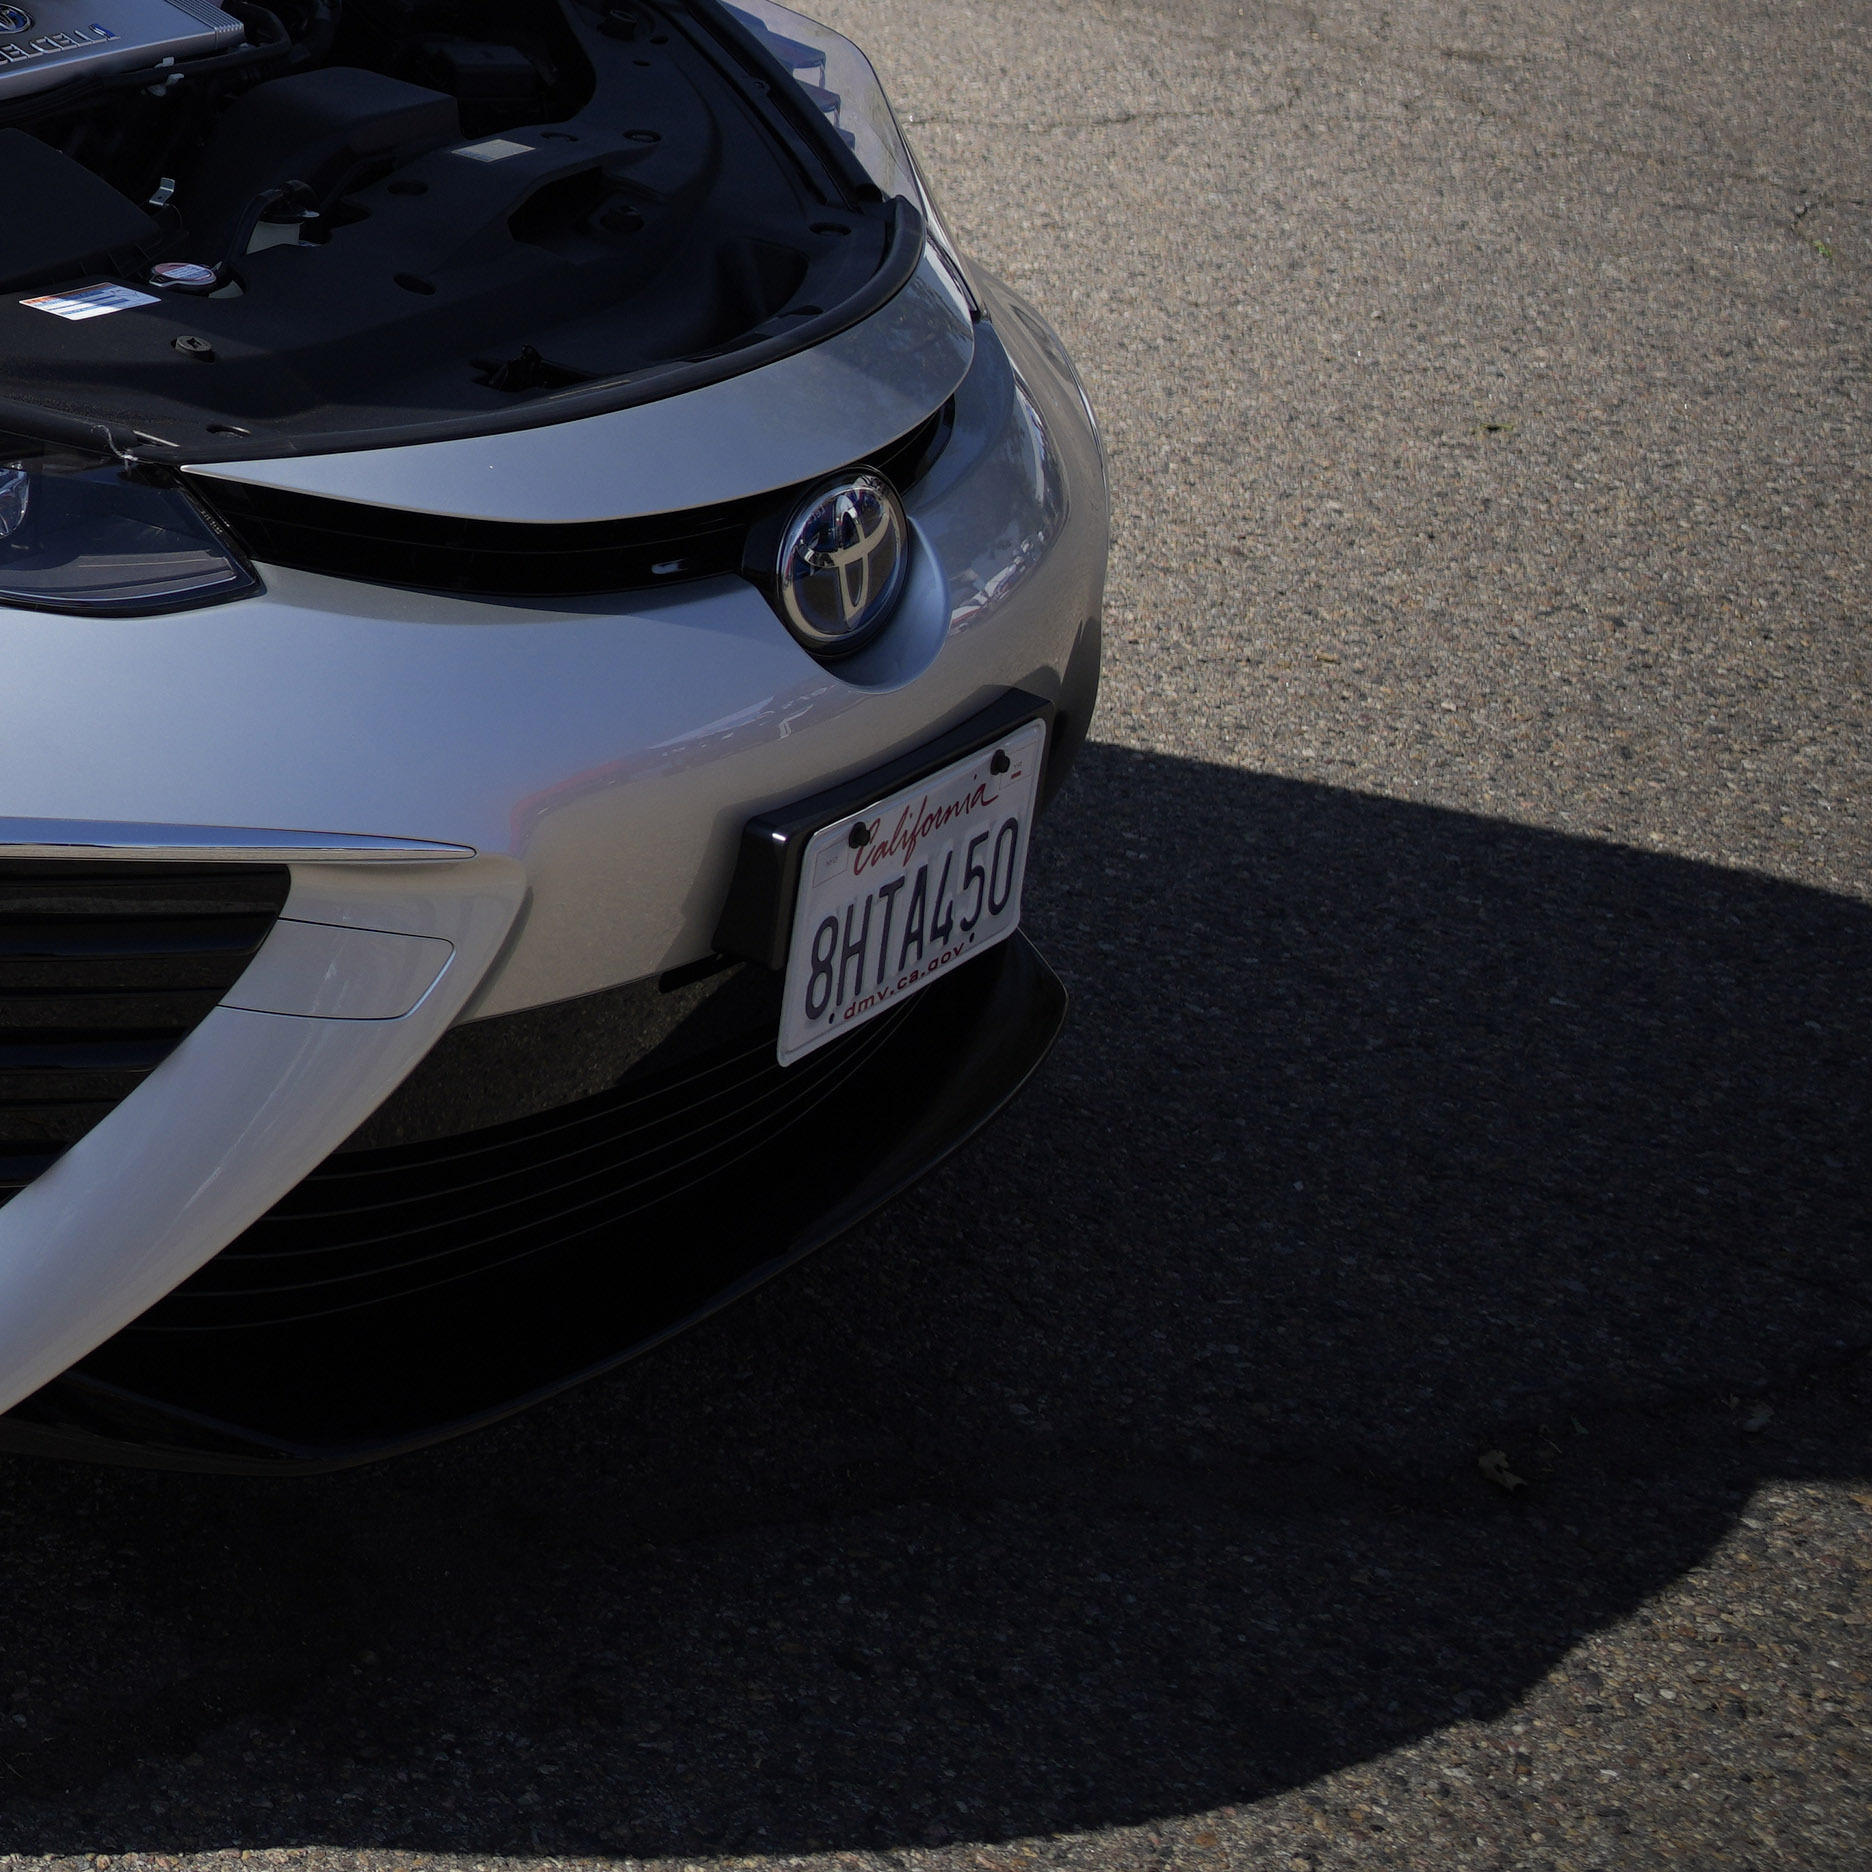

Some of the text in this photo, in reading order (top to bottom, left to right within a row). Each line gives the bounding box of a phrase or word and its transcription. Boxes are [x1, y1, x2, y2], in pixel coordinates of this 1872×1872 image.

[853, 774, 1000, 876] California
[804, 815, 1019, 1021] 8HTA450
[843, 942, 965, 1021] dmv.ca.gov
